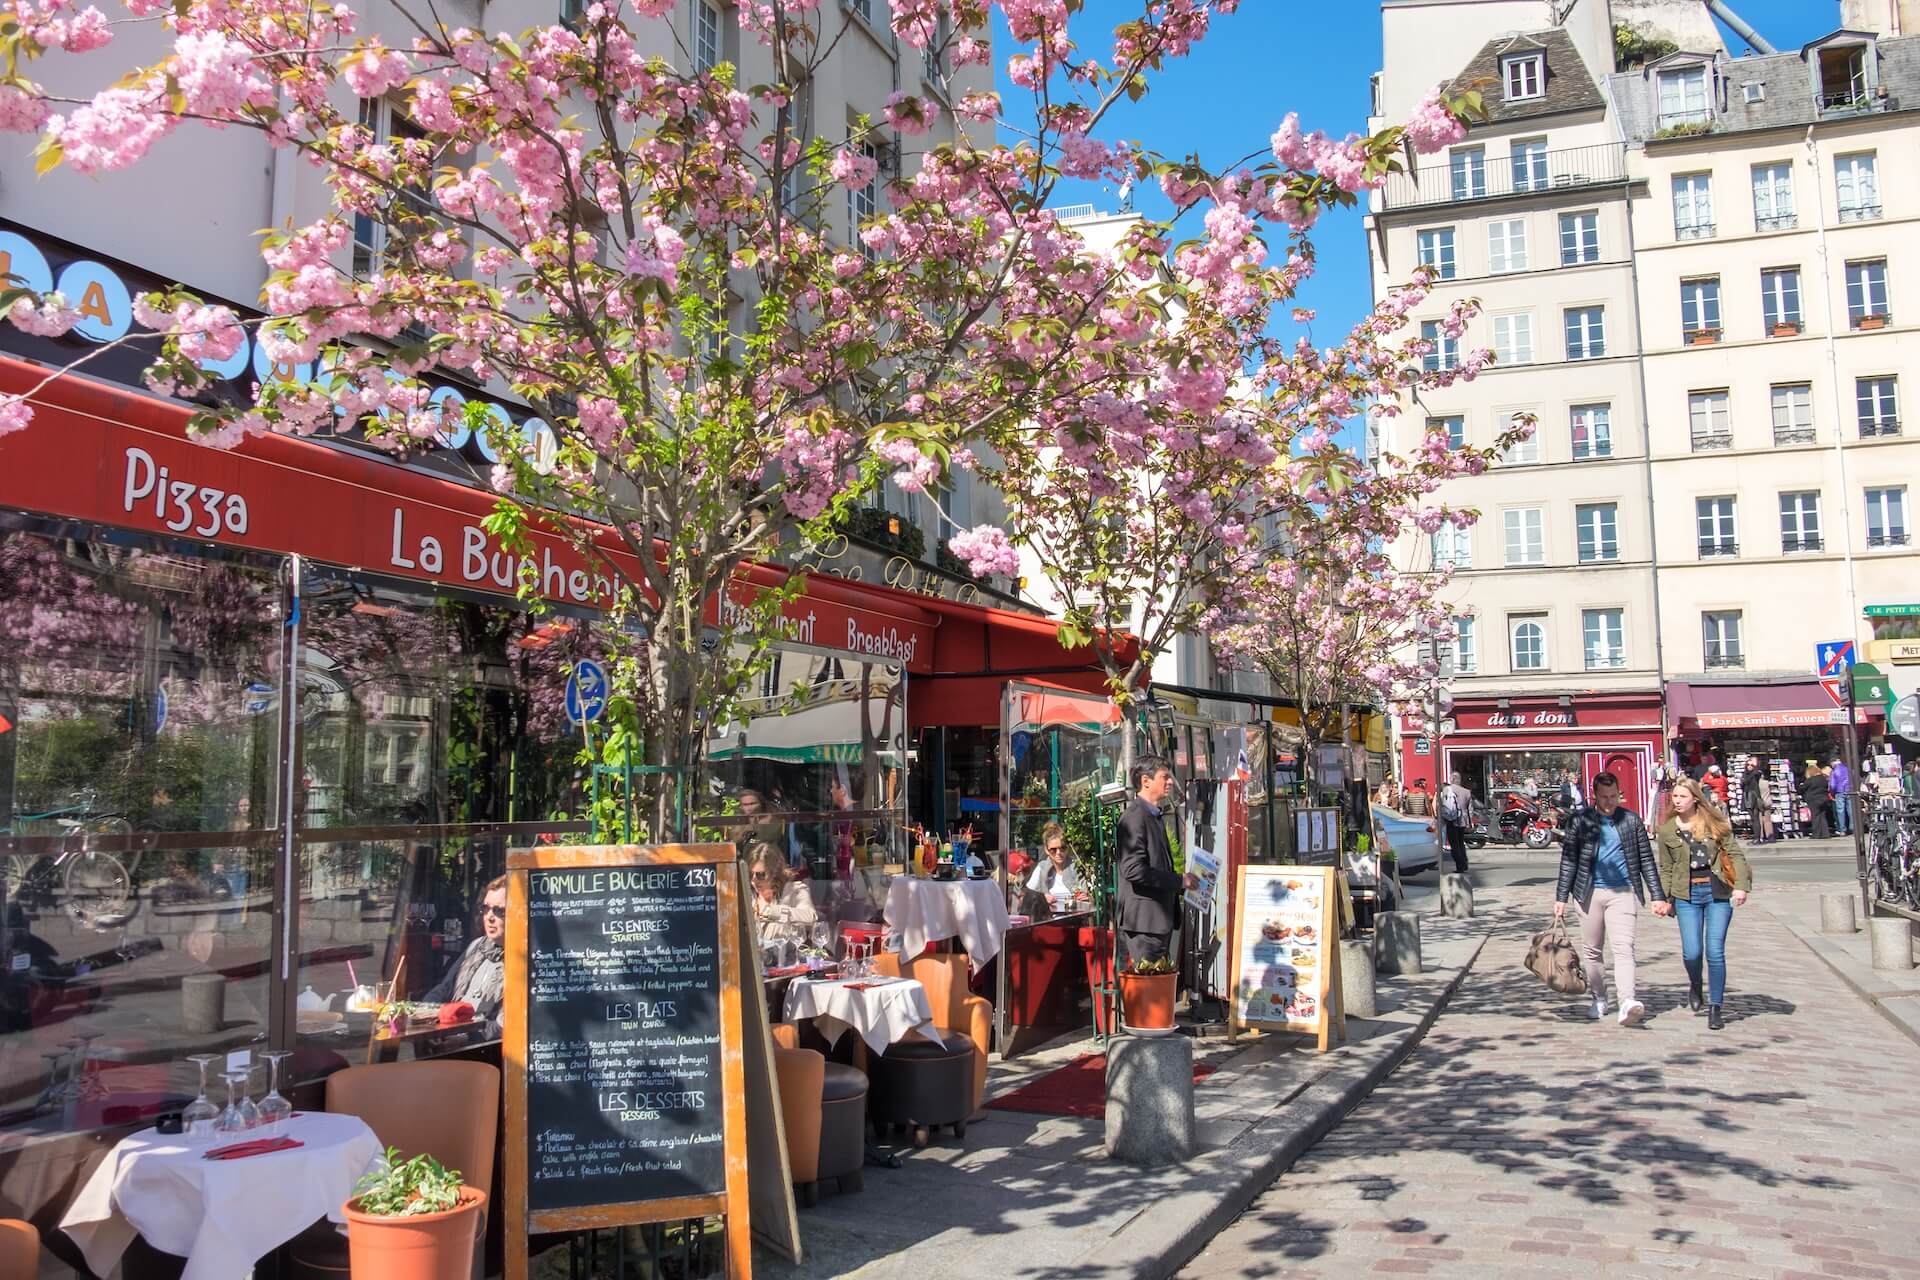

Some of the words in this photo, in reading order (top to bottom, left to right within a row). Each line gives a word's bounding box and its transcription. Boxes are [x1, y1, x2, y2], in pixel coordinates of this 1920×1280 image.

[124, 446, 248, 537] Pizza
[391, 508, 443, 574] La
[463, 526, 624, 605] Bucheri
[847, 617, 917, 662] Breakfast
[1534, 710, 1573, 725] dom
[1782, 713, 1825, 724] Souven
[609, 870, 679, 892] BUCHERIE
[602, 921, 625, 935] LES
[611, 932, 651, 944] STARTERS
[606, 1003, 633, 1021] LES
[637, 1001, 678, 1019] PLATS
[598, 1093, 629, 1112] LES
[635, 1090, 705, 1110] DESSERTS
[620, 1110, 660, 1122] DESSERTS
